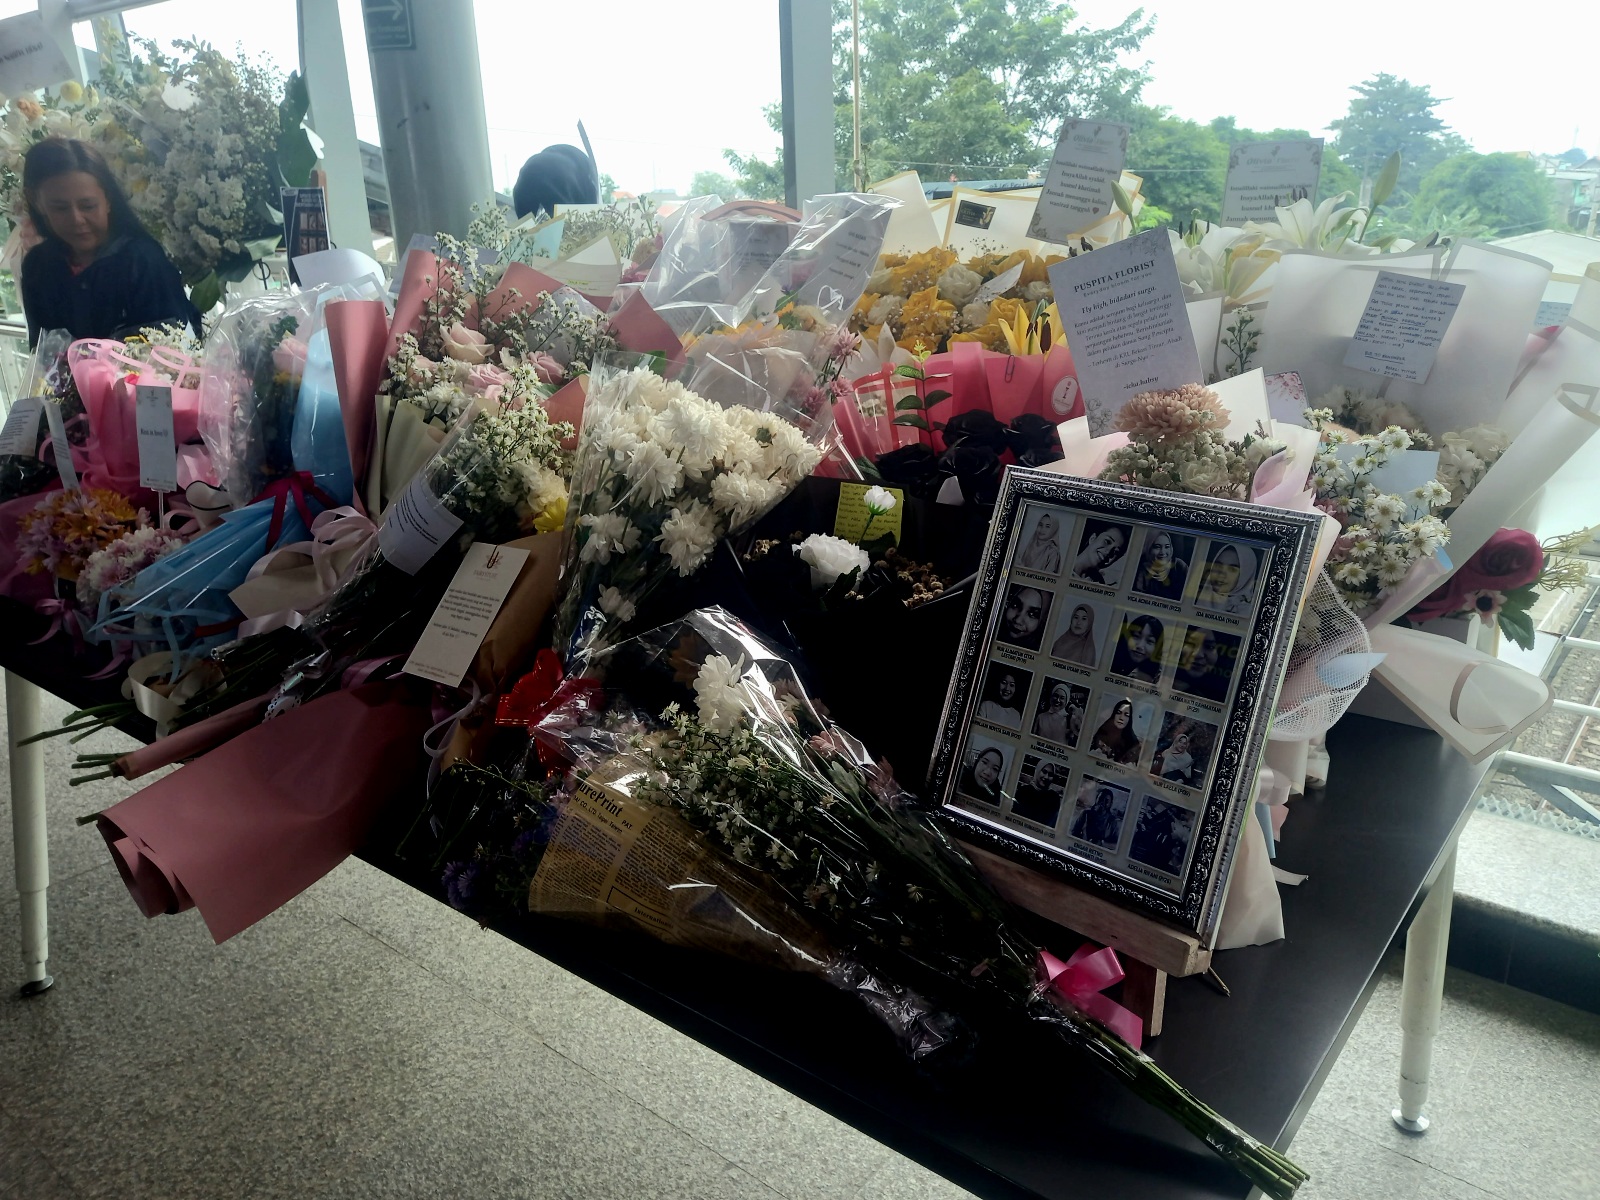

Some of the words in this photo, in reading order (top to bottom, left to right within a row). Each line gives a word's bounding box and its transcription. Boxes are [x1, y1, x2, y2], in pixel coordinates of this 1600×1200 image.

[1046, 189, 1064, 199] Jannah
[1074, 274, 1114, 292] PUSPITA
[1116, 260, 1156, 278] FLORIST
[1084, 285, 1110, 297] Everyday
[1111, 279, 1129, 288] bloom
[1082, 306, 1092, 314] Fly
[1093, 300, 1108, 311] high,
[1109, 291, 1136, 304] bidadari
